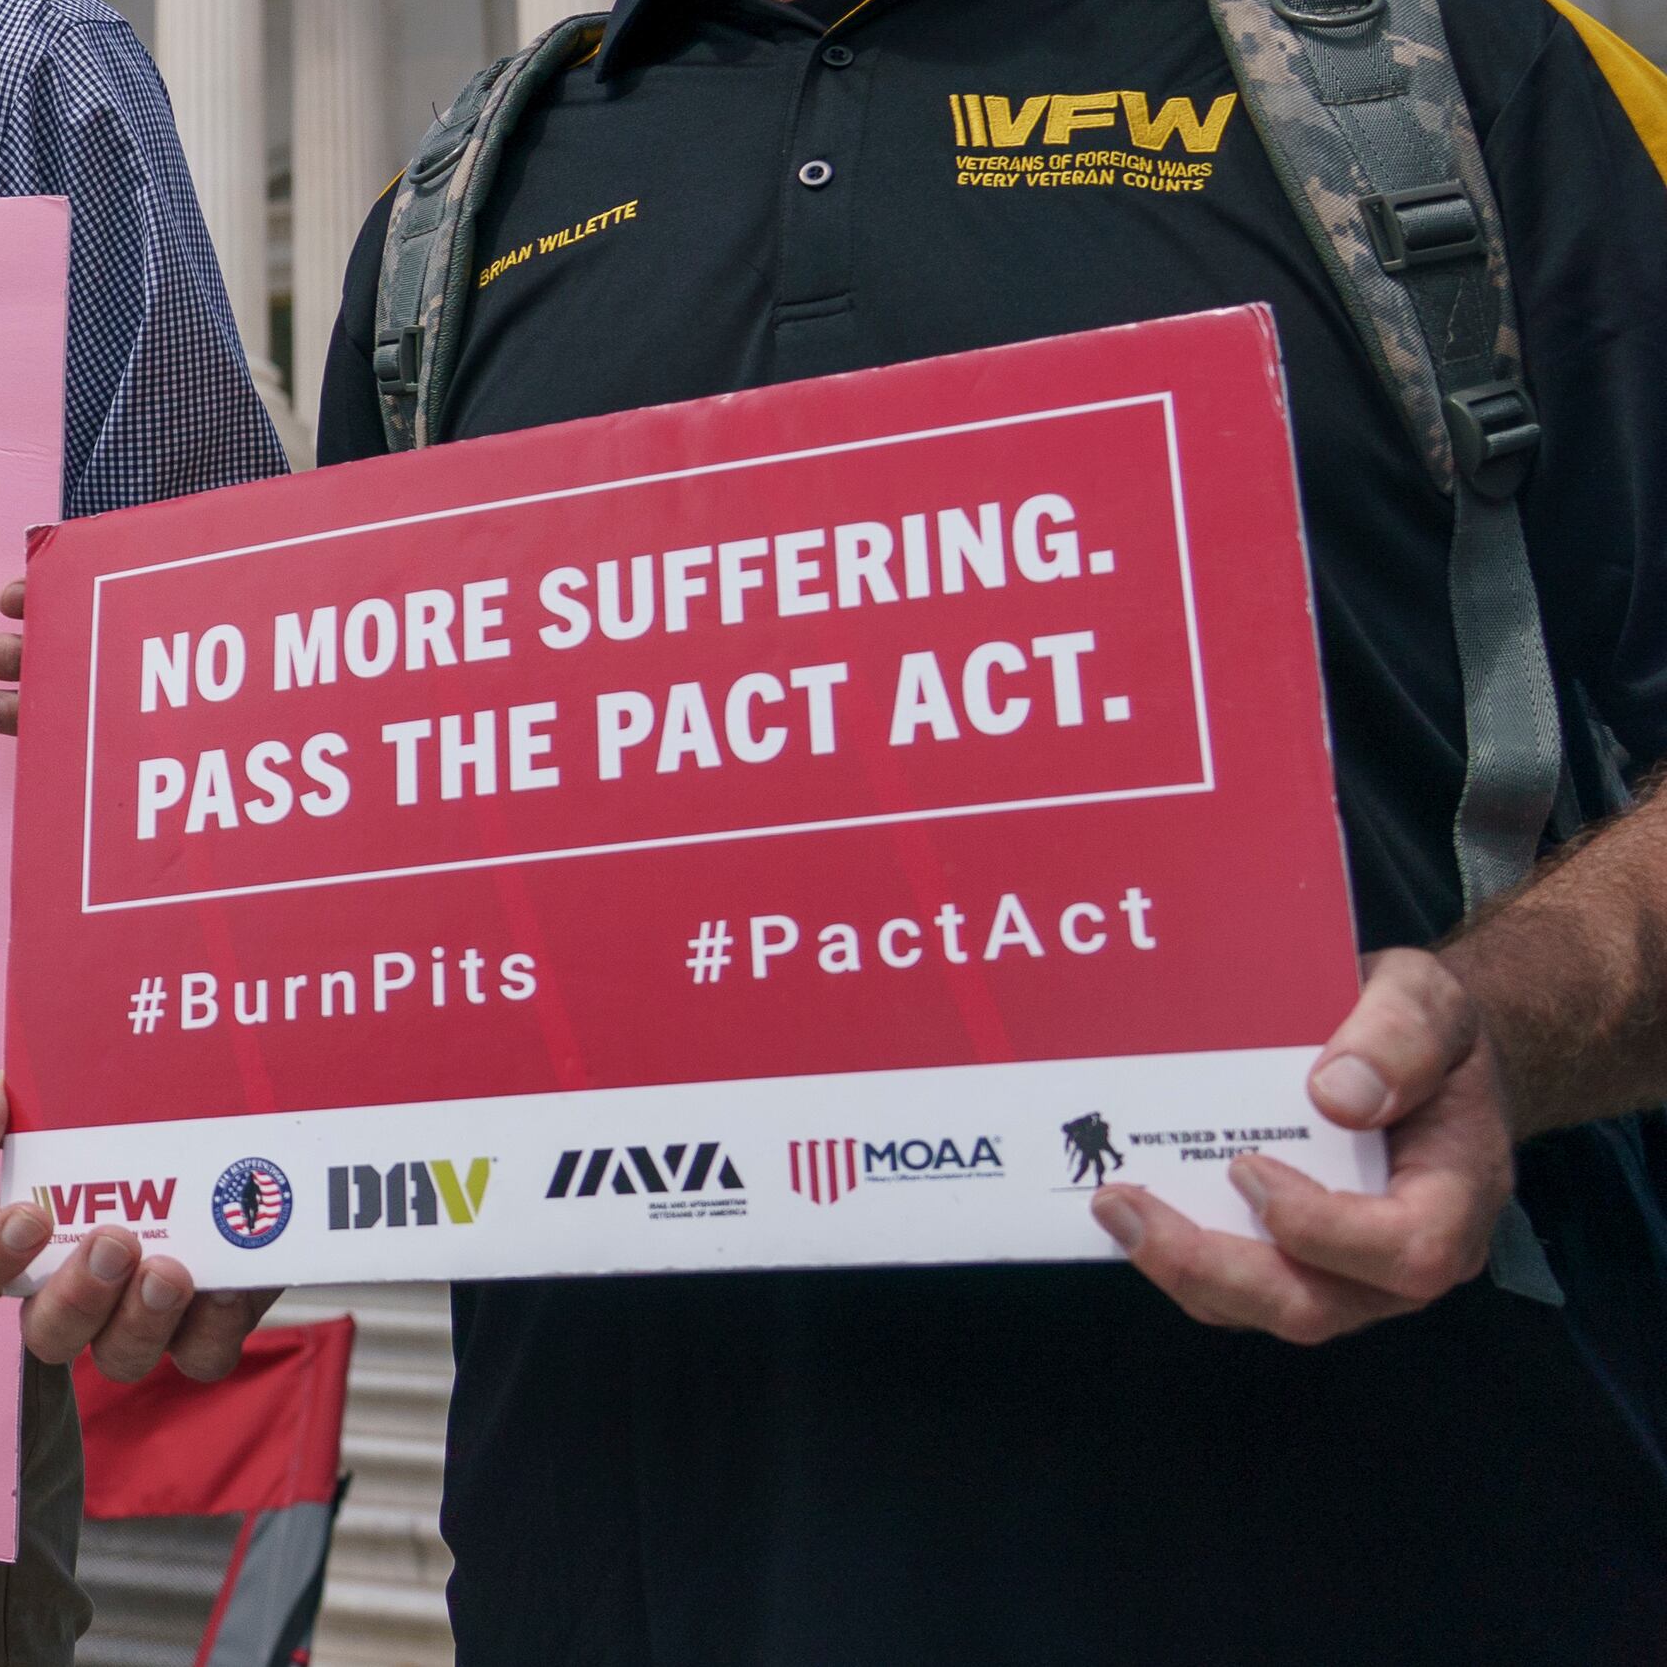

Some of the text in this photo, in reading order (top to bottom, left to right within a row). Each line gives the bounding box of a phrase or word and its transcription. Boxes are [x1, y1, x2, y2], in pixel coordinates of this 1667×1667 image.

[984, 90, 1238, 152] VFW
[955, 150, 1213, 178] VETERANS OF FOREIGN WARS
[956, 170, 1205, 192] EVERY VETERAN COUNTS
[478, 199, 639, 288] BRIAN WILLETTE
[140, 493, 1115, 713] NO MORE SUFFERING.
[136, 630, 1131, 840] PASS THE PACT ACT.
[127, 887, 1157, 1034] #BurnPits #PactAct
[864, 1136, 1003, 1173] MOAA
[1128, 1126, 1310, 1146] WOUNDED WARRIOR
[49, 1178, 177, 1225] VFW
[327, 1156, 491, 1231] DAV
